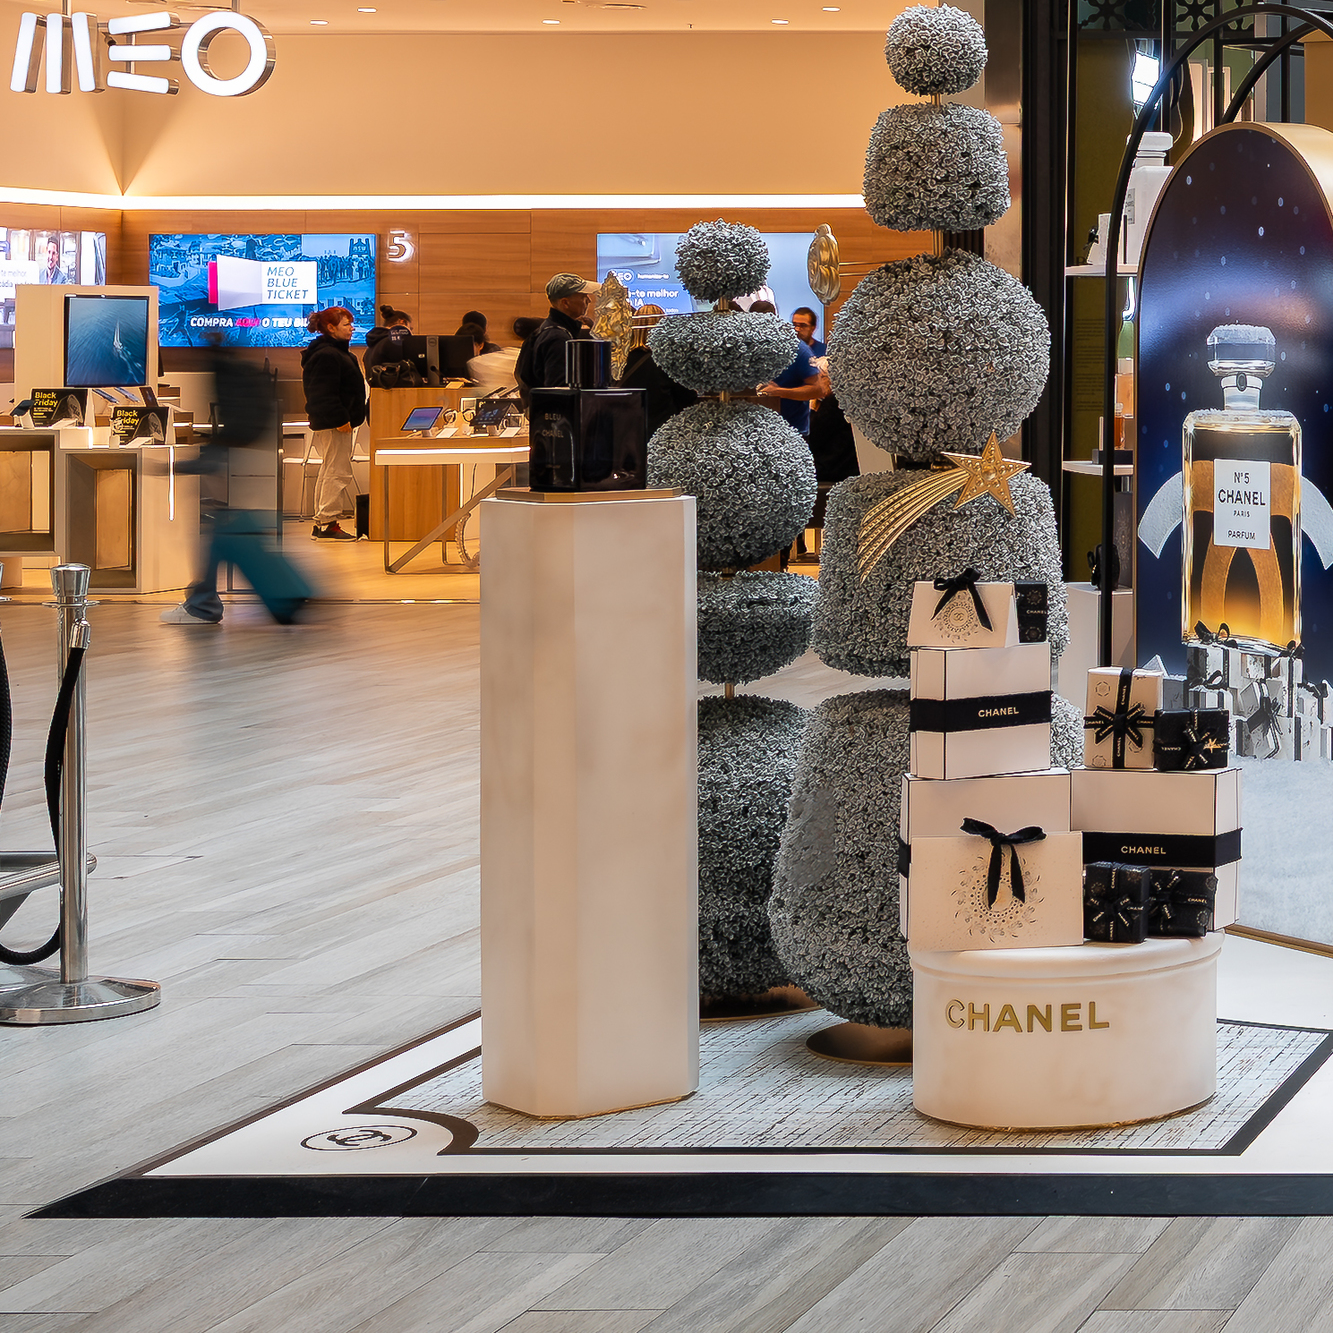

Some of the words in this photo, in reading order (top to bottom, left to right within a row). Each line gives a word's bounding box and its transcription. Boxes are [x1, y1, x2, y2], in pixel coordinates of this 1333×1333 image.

[10, 11, 276, 97] MEO
[388, 230, 414, 262] 5
[267, 267, 294, 276] MEO
[267, 278, 297, 288] BLUE
[267, 289, 308, 299] TICKET
[647, 289, 678, 297] melhor
[191, 317, 233, 327] COMPRA
[262, 318, 269, 327] O
[272, 317, 292, 327] TEU
[34, 391, 56, 399] Black
[116, 410, 138, 418] Black
[542, 429, 564, 438] CHANEL
[1218, 489, 1266, 505] CHANEL
[1233, 510, 1250, 518] PARIS
[1228, 530, 1255, 540] PARFUM
[978, 706, 1019, 717] CHANEL
[1121, 845, 1166, 855] CHANEL
[945, 998, 1110, 1033] CHANEL
